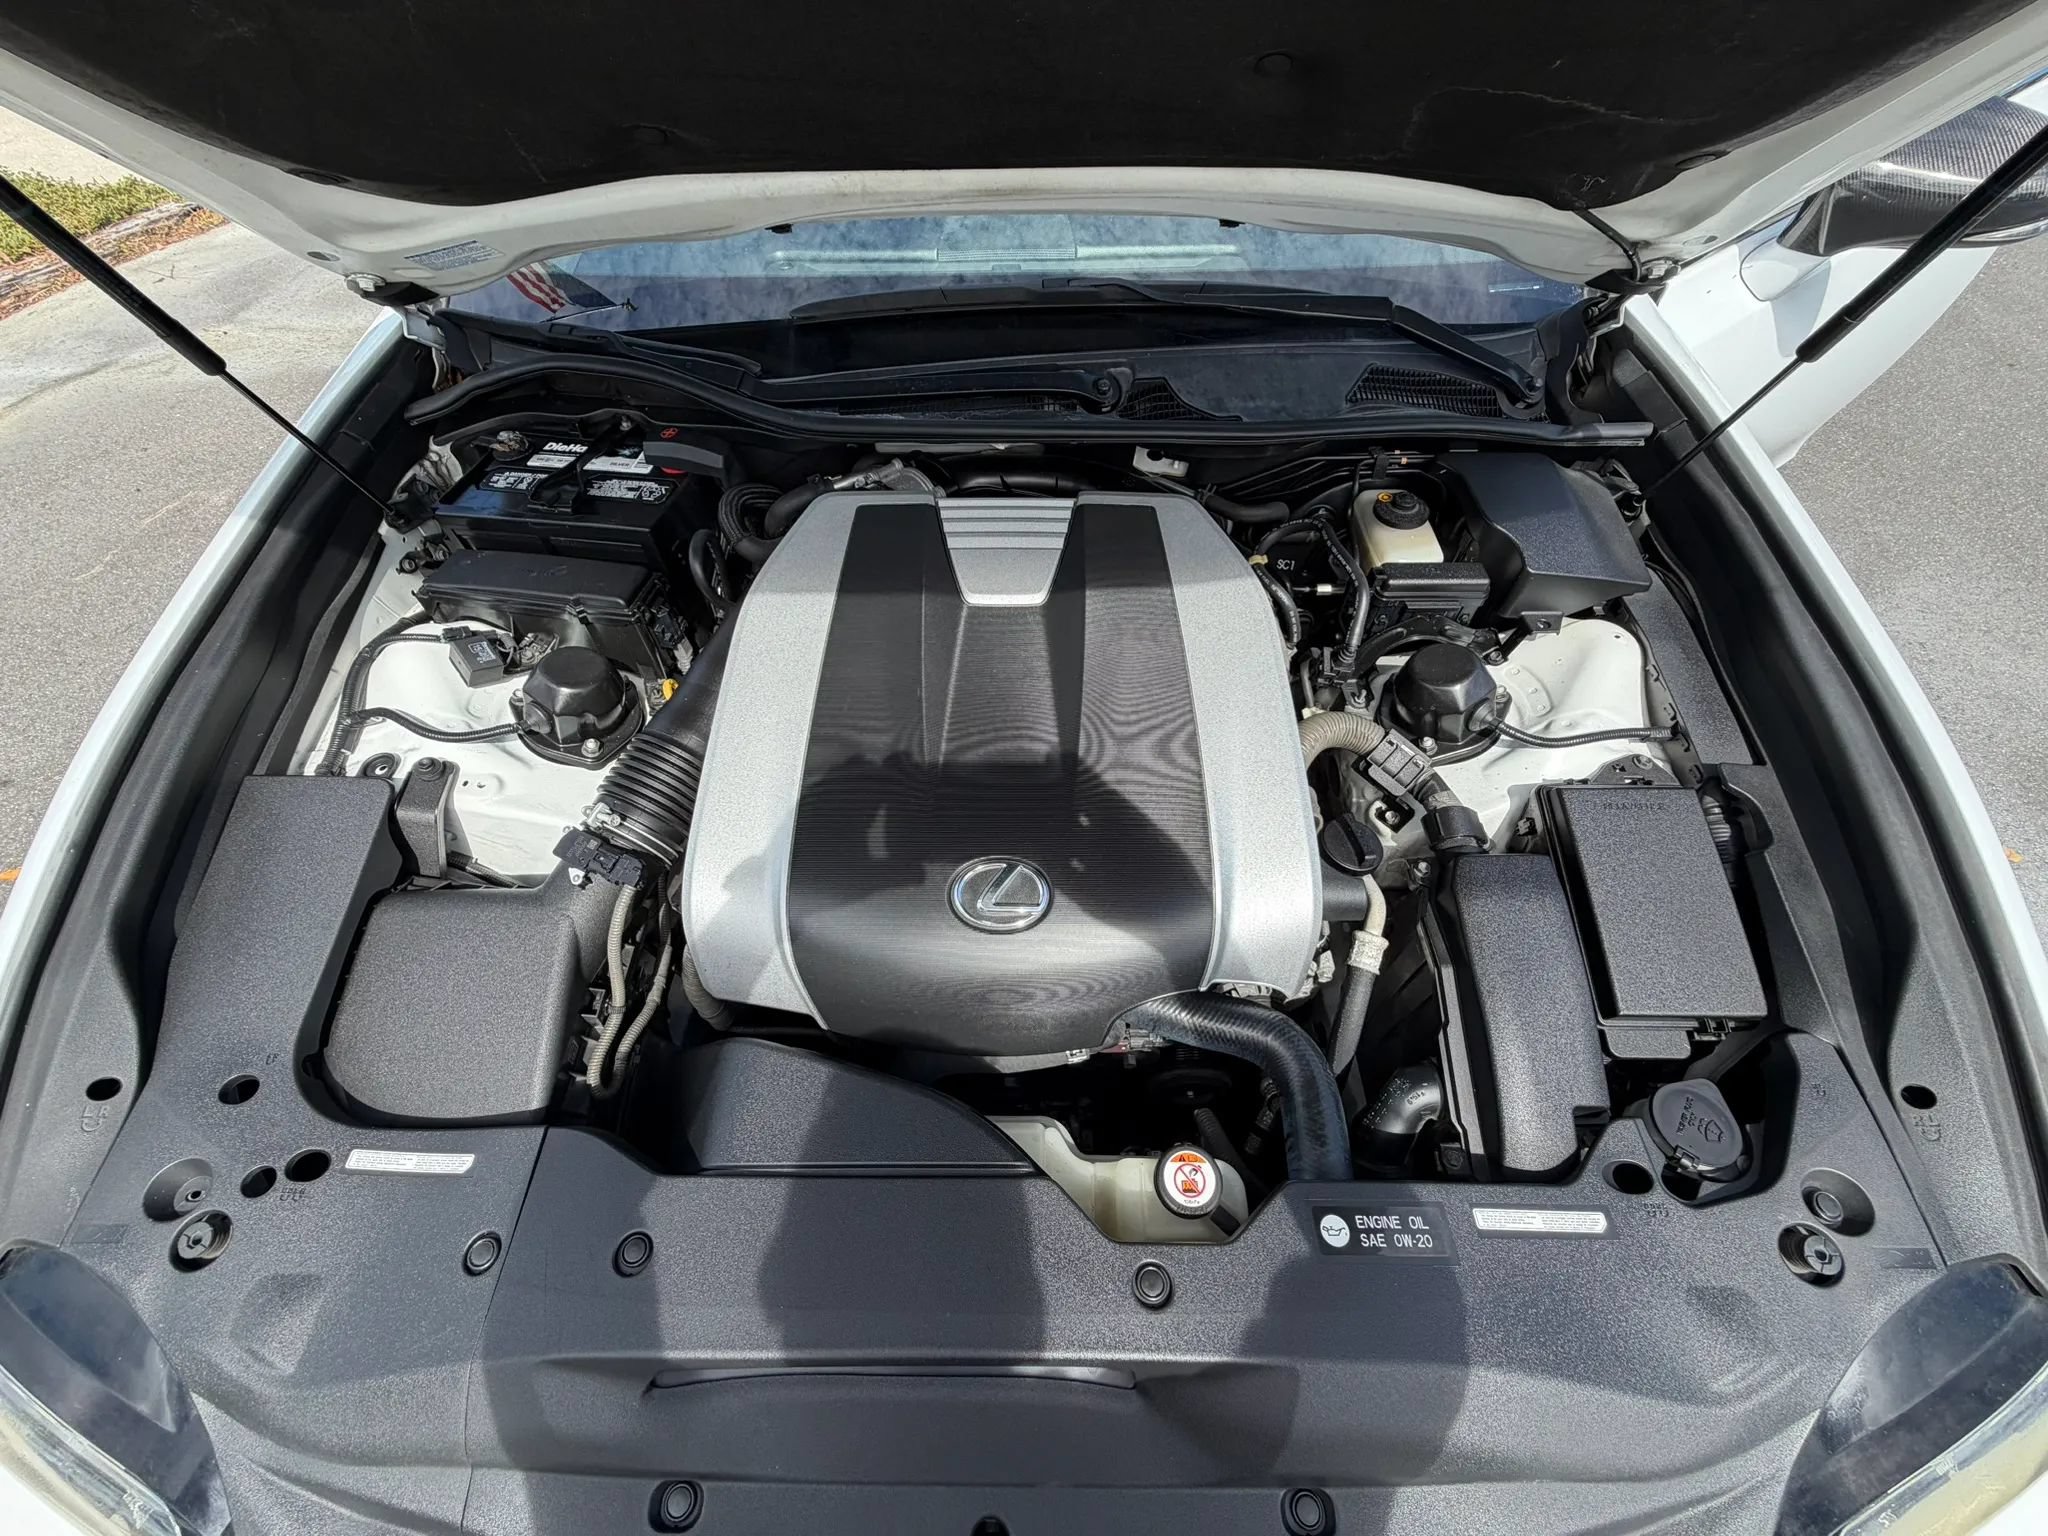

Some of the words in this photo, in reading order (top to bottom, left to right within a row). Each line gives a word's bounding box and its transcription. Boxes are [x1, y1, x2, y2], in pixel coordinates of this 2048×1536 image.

[542, 441, 589, 453] DieHa
[1354, 1215, 1402, 1229] ENGINE
[1408, 1215, 1430, 1230] OIL
[1359, 1233, 1388, 1248] SAE
[1393, 1233, 1433, 1248] 0W-20
